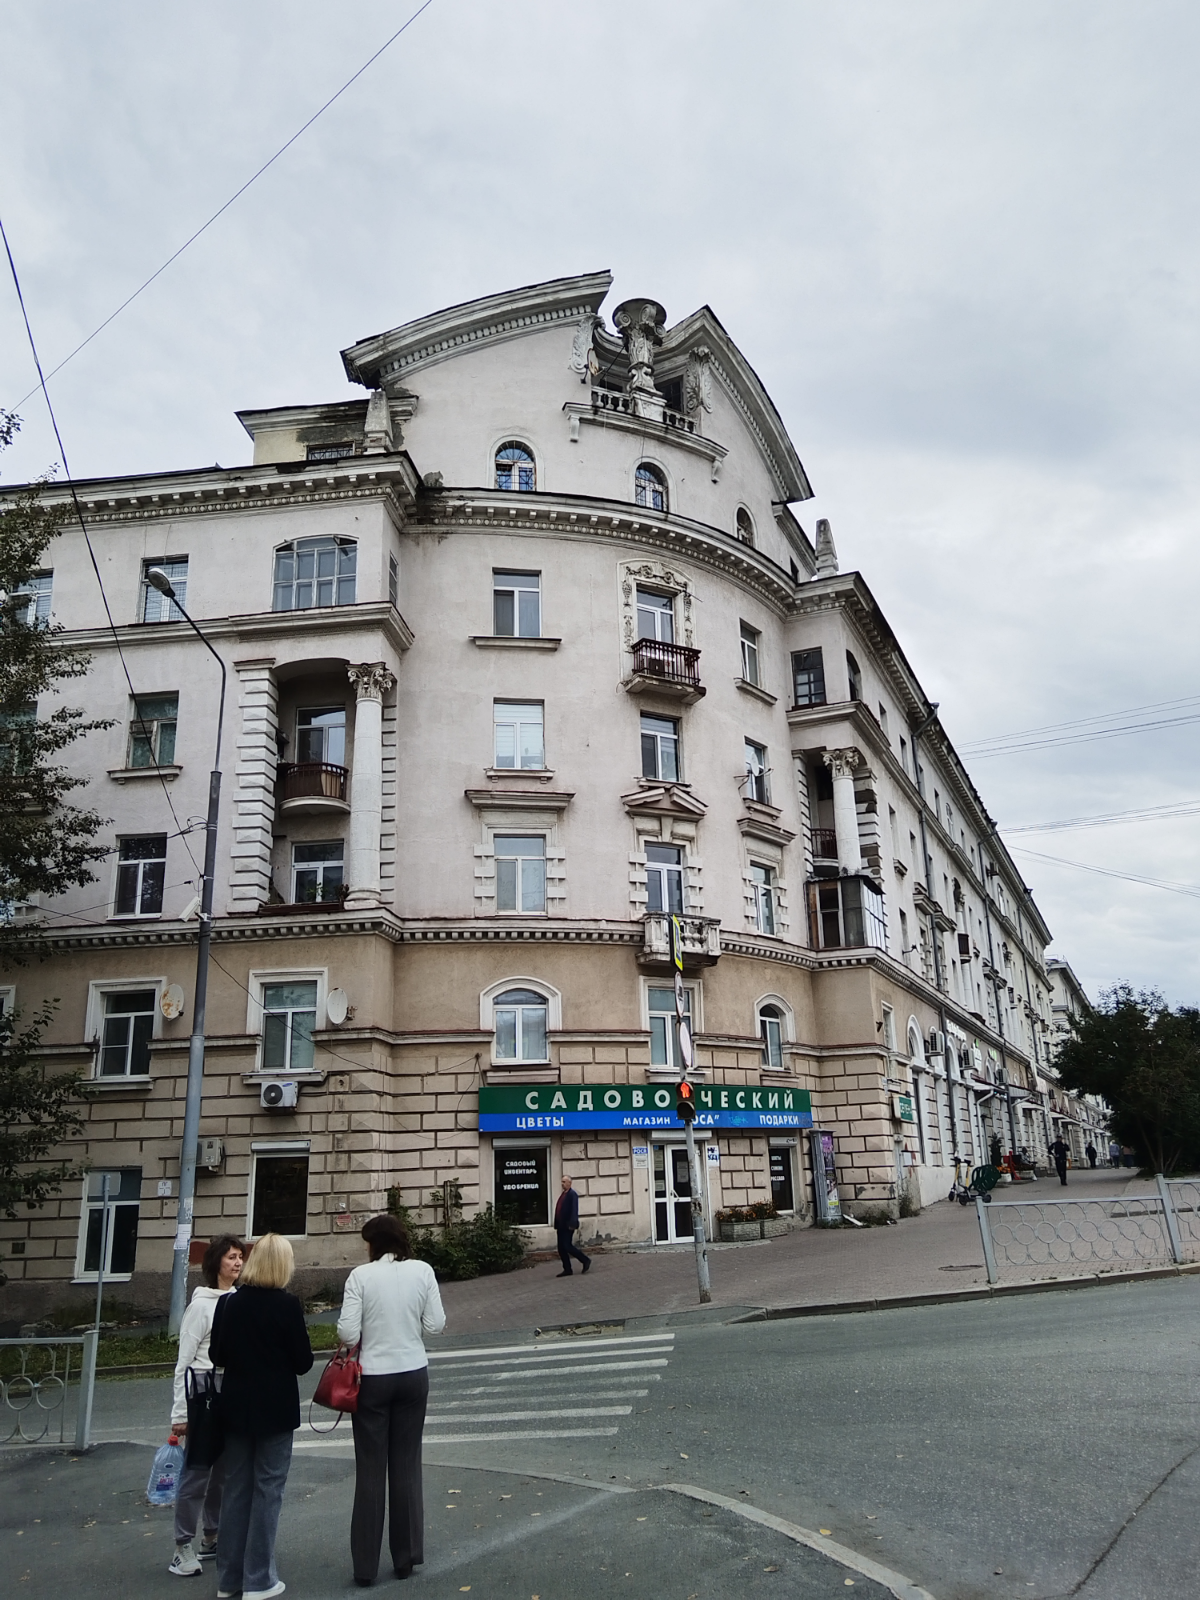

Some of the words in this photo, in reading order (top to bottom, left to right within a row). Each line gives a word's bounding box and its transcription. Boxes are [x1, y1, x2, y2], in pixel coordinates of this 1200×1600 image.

[525, 1089, 794, 1111] САДОВОЧЕСКИЙ
[516, 1116, 564, 1129] ЦВЕТЫ
[623, 1116, 671, 1126] МАГАЗИН
[759, 1114, 799, 1126] ПОДАРКИ
